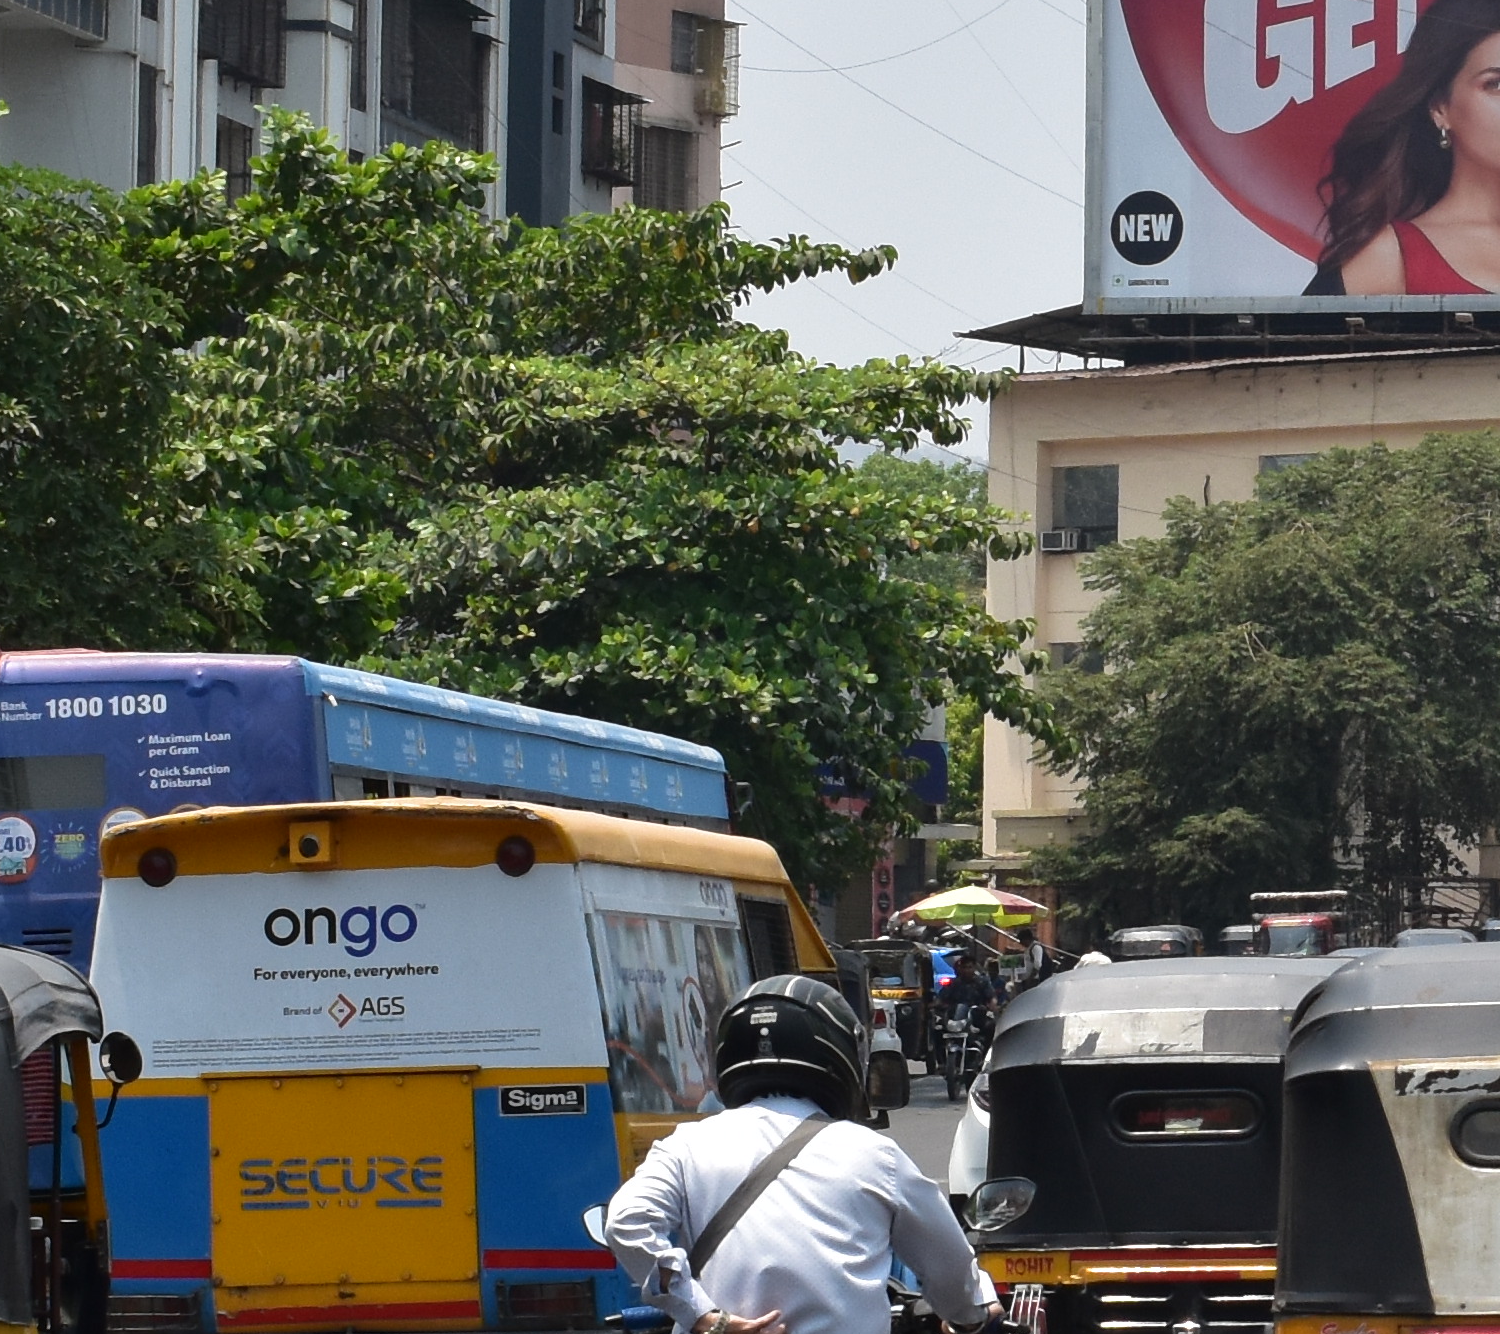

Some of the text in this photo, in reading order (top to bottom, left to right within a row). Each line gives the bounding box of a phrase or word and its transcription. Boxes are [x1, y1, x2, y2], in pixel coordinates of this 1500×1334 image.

[1120, 214, 1173, 242] NEW
[1, 701, 28, 711] Bank
[45, 694, 167, 718] 1800 1030
[1, 711, 42, 722] Number
[149, 732, 231, 745] Maximum Loan
[149, 745, 199, 758] per Gram
[150, 765, 231, 778] Quick Sanction
[150, 777, 212, 789] & Disbursal
[264, 904, 418, 957] ongo
[254, 963, 439, 982] For everyone, everywhere
[283, 1007, 311, 1016] Brand
[360, 996, 405, 1016] AGS
[508, 1089, 578, 1110] Sigma
[240, 1157, 443, 1196] SECURE
[1005, 1258, 1054, 1274] ROHIT
